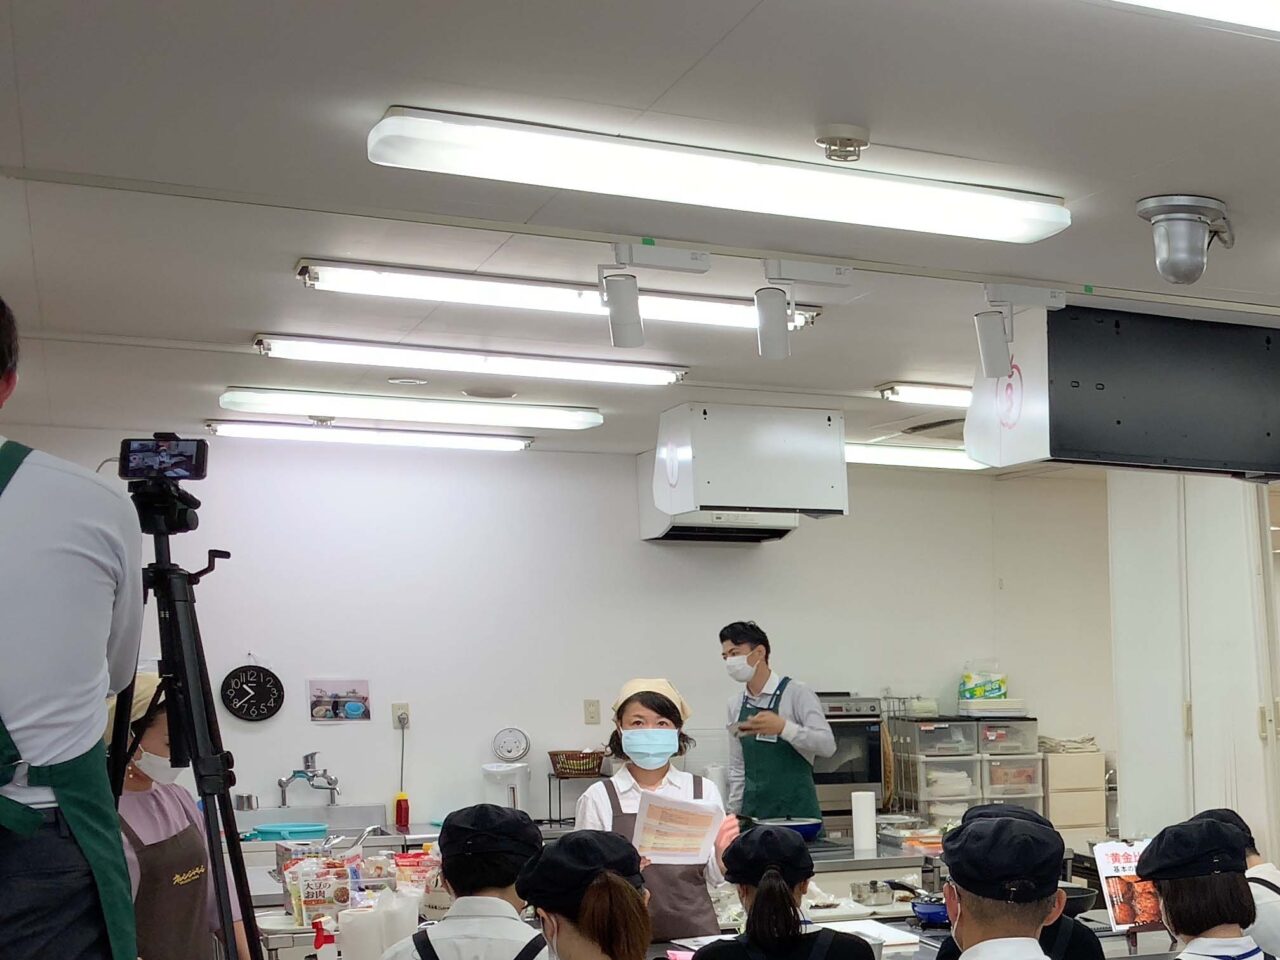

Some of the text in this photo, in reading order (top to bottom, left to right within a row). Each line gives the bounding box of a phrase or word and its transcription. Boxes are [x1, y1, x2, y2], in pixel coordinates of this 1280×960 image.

[240, 673, 246, 683] 11
[248, 670, 257, 681] 12
[231, 679, 240, 689] 10
[265, 677, 273, 688] 2
[227, 689, 235, 699] 9
[270, 688, 278, 698] 3
[232, 699, 239, 709] 8
[259, 703, 267, 714] 5
[267, 699, 274, 708] 4
[242, 704, 248, 714] 7
[250, 706, 258, 717] 6
[305, 881, 331, 891] 大豆の
[304, 890, 326, 900] お肉
